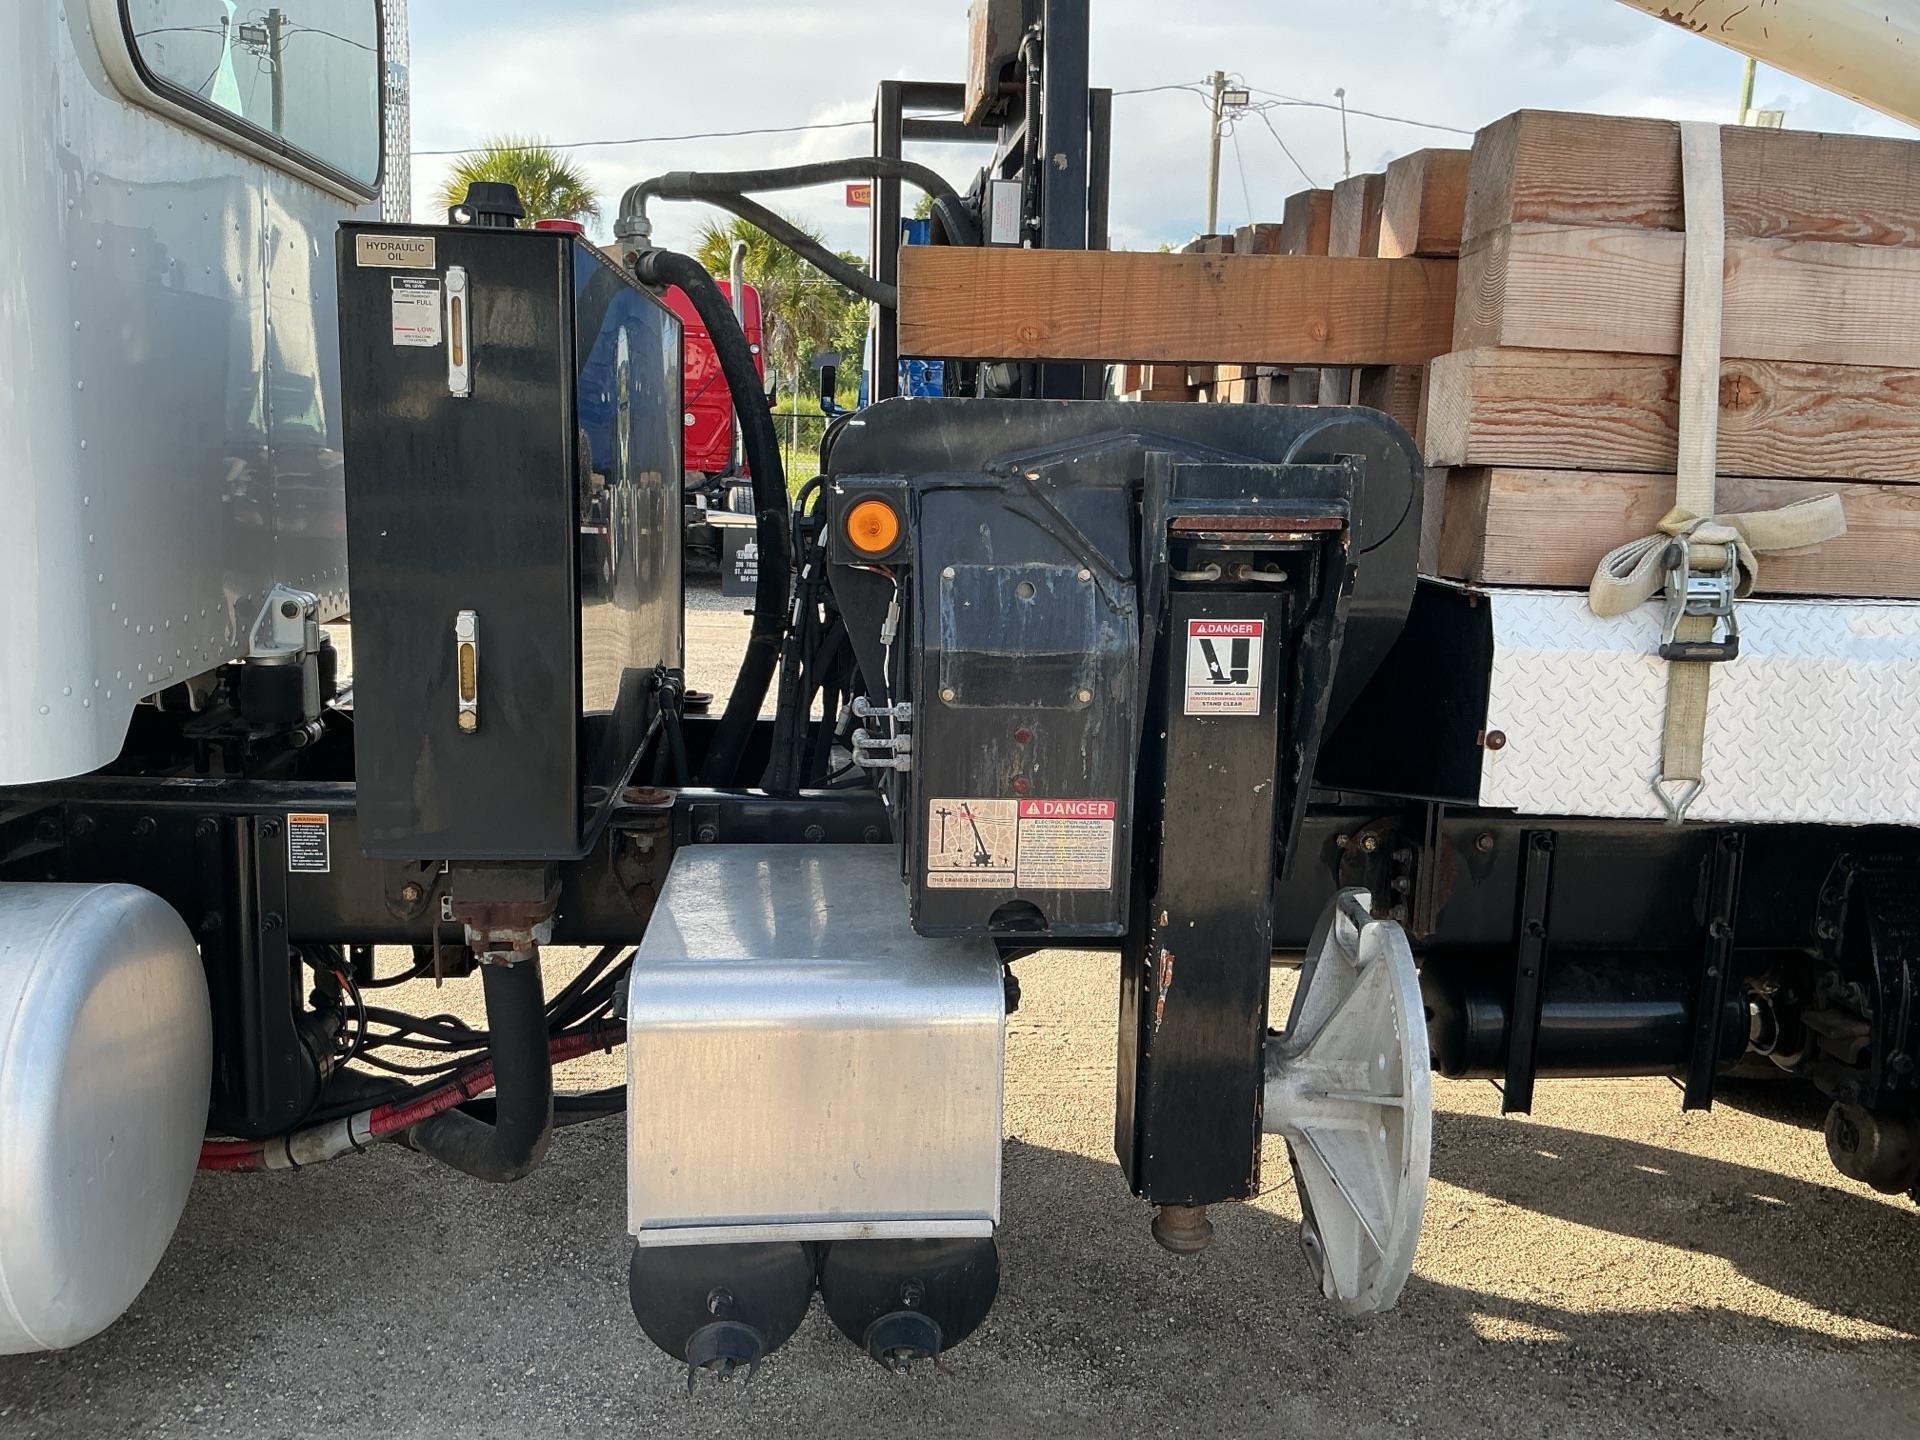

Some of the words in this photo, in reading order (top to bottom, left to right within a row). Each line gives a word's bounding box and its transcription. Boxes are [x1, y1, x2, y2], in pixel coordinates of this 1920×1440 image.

[366, 242, 425, 252] HYDRAULIC
[388, 252, 404, 260] OIL
[1207, 624, 1253, 633] DANGER
[1043, 803, 1109, 815] DANGER
